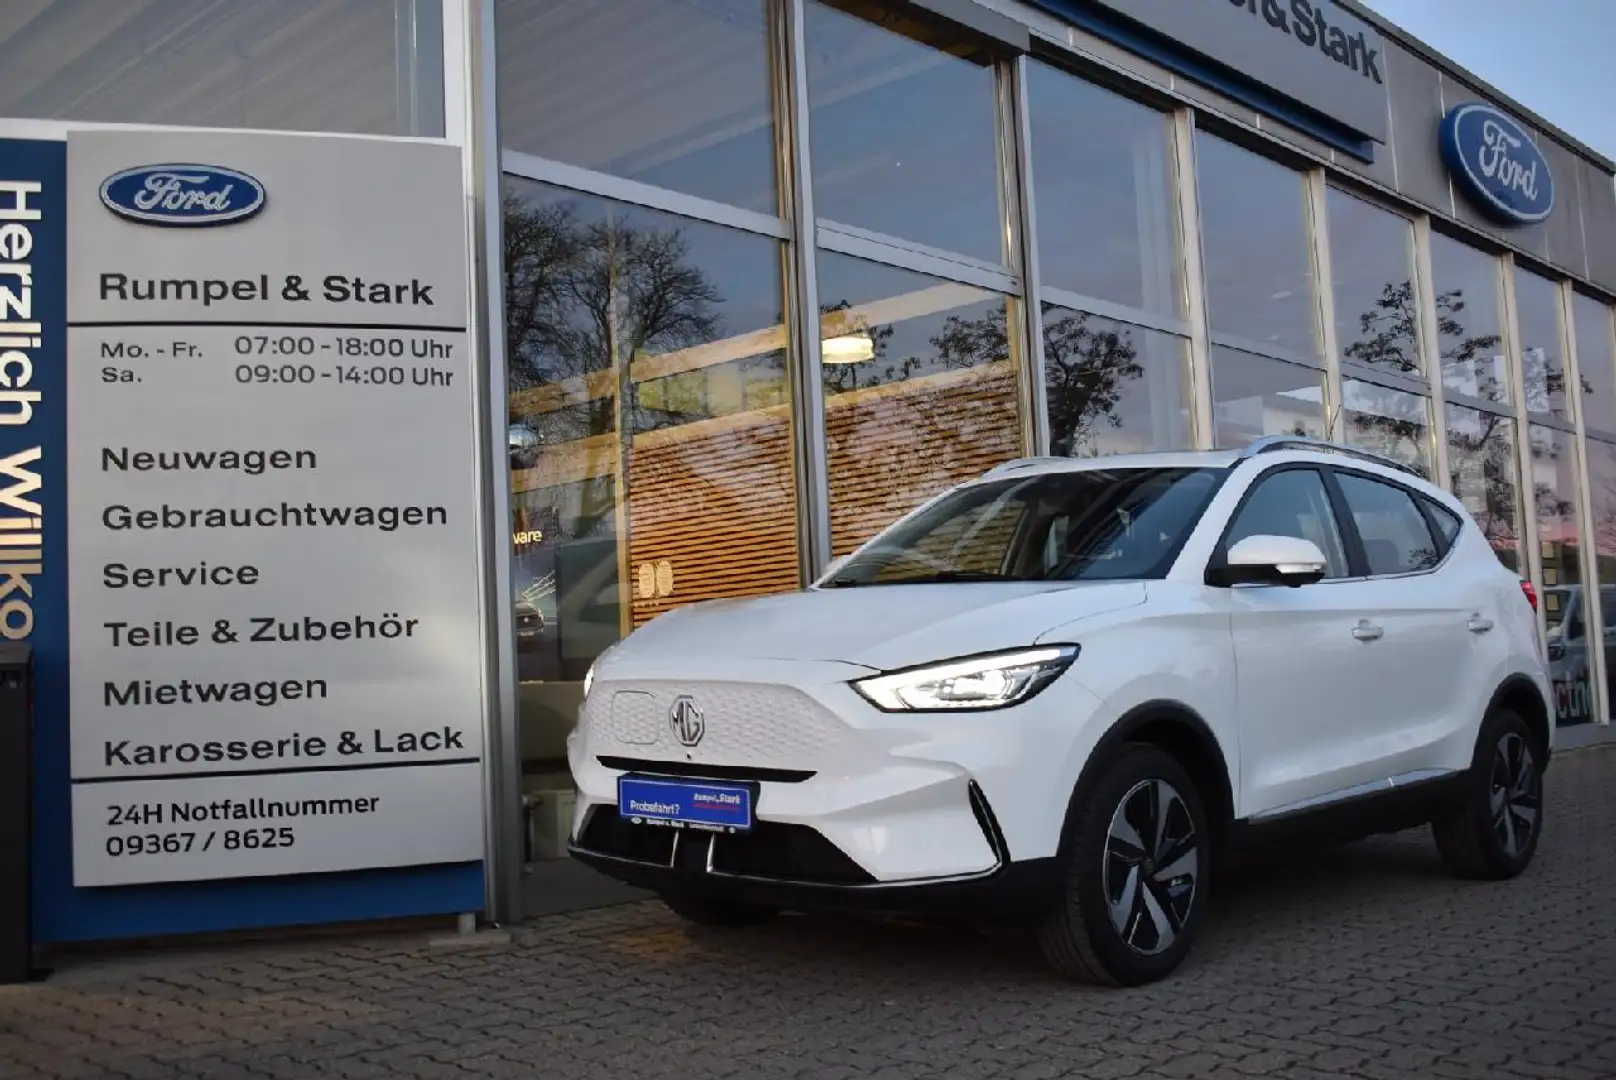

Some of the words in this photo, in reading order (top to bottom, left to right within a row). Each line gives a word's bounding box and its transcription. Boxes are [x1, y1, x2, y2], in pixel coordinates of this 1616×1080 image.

[1479, 120, 1538, 200] Ford
[134, 172, 234, 211] Ford
[0, 181, 42, 425] Herzlich
[100, 273, 268, 306] Rumpel
[282, 275, 310, 301] &
[324, 276, 433, 305] Stark
[101, 343, 148, 358] Mo.
[173, 342, 202, 357] Fr.
[412, 339, 452, 358] Uhr
[102, 367, 141, 382] Sa.
[412, 368, 453, 386] Uhr
[102, 448, 316, 475] Neuwagen
[103, 503, 446, 531] Gebrauchtwagen
[104, 562, 258, 588] Service
[104, 622, 199, 646] Teile
[212, 620, 238, 643] &
[250, 613, 418, 642] Zubehör
[104, 677, 327, 707] Mietwagen
[104, 733, 327, 766] Karosserie
[337, 731, 364, 755] &
[375, 727, 463, 752] Lack
[108, 804, 162, 825] 24H
[172, 798, 379, 822] Notfallnummer
[106, 833, 195, 856] 09367
[202, 832, 215, 851] /
[224, 828, 294, 849] 8625
